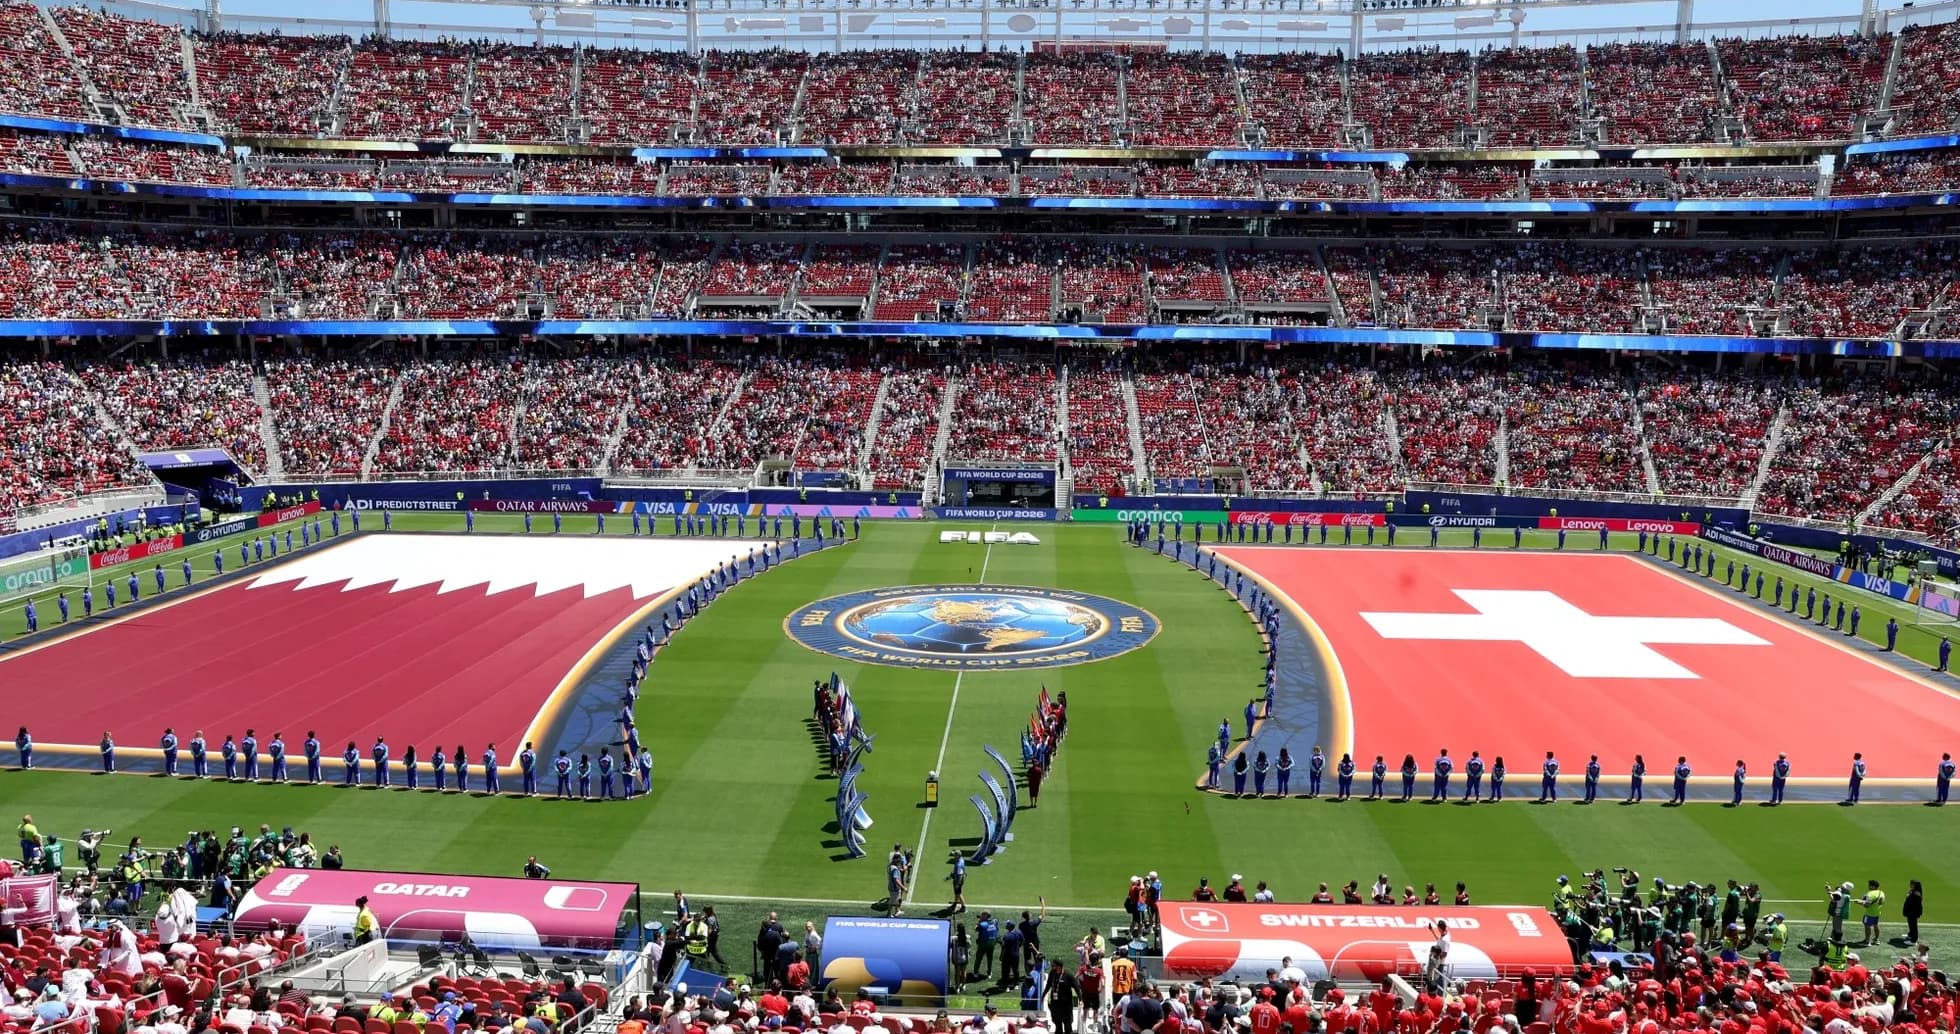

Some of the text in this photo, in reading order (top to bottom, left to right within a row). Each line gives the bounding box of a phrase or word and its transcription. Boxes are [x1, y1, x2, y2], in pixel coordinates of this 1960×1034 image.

[552, 483, 571, 491] FIFA
[344, 500, 458, 510] ADI PREDICTSTREET
[496, 502, 588, 512] QATAR AIRWAYS
[643, 502, 675, 514] VISA
[1441, 498, 1461, 506] FIFA
[277, 508, 305, 522] Lenovo
[708, 503, 739, 515] VISA
[996, 510, 1014, 518] CUP
[1117, 510, 1183, 522] aramco
[1449, 517, 1496, 526] HYUNDAI
[212, 521, 246, 537] HYUNDAI
[1561, 519, 1607, 529] Lenovo
[1627, 520, 1674, 533] Lenovo
[940, 531, 1040, 543] FIFA
[1704, 529, 1759, 552] ADI PREDICTSTREET
[1763, 545, 1831, 576] QATAR AIRWAYS
[1937, 556, 1953, 568] FIFA
[1864, 573, 1891, 595] VISA
[801, 610, 831, 627] FIFA
[1119, 616, 1143, 633] FIFA
[838, 646, 878, 658] FIFA
[882, 654, 961, 665] WORLD
[1016, 651, 1089, 664] 2026
[373, 882, 471, 898] QATAR
